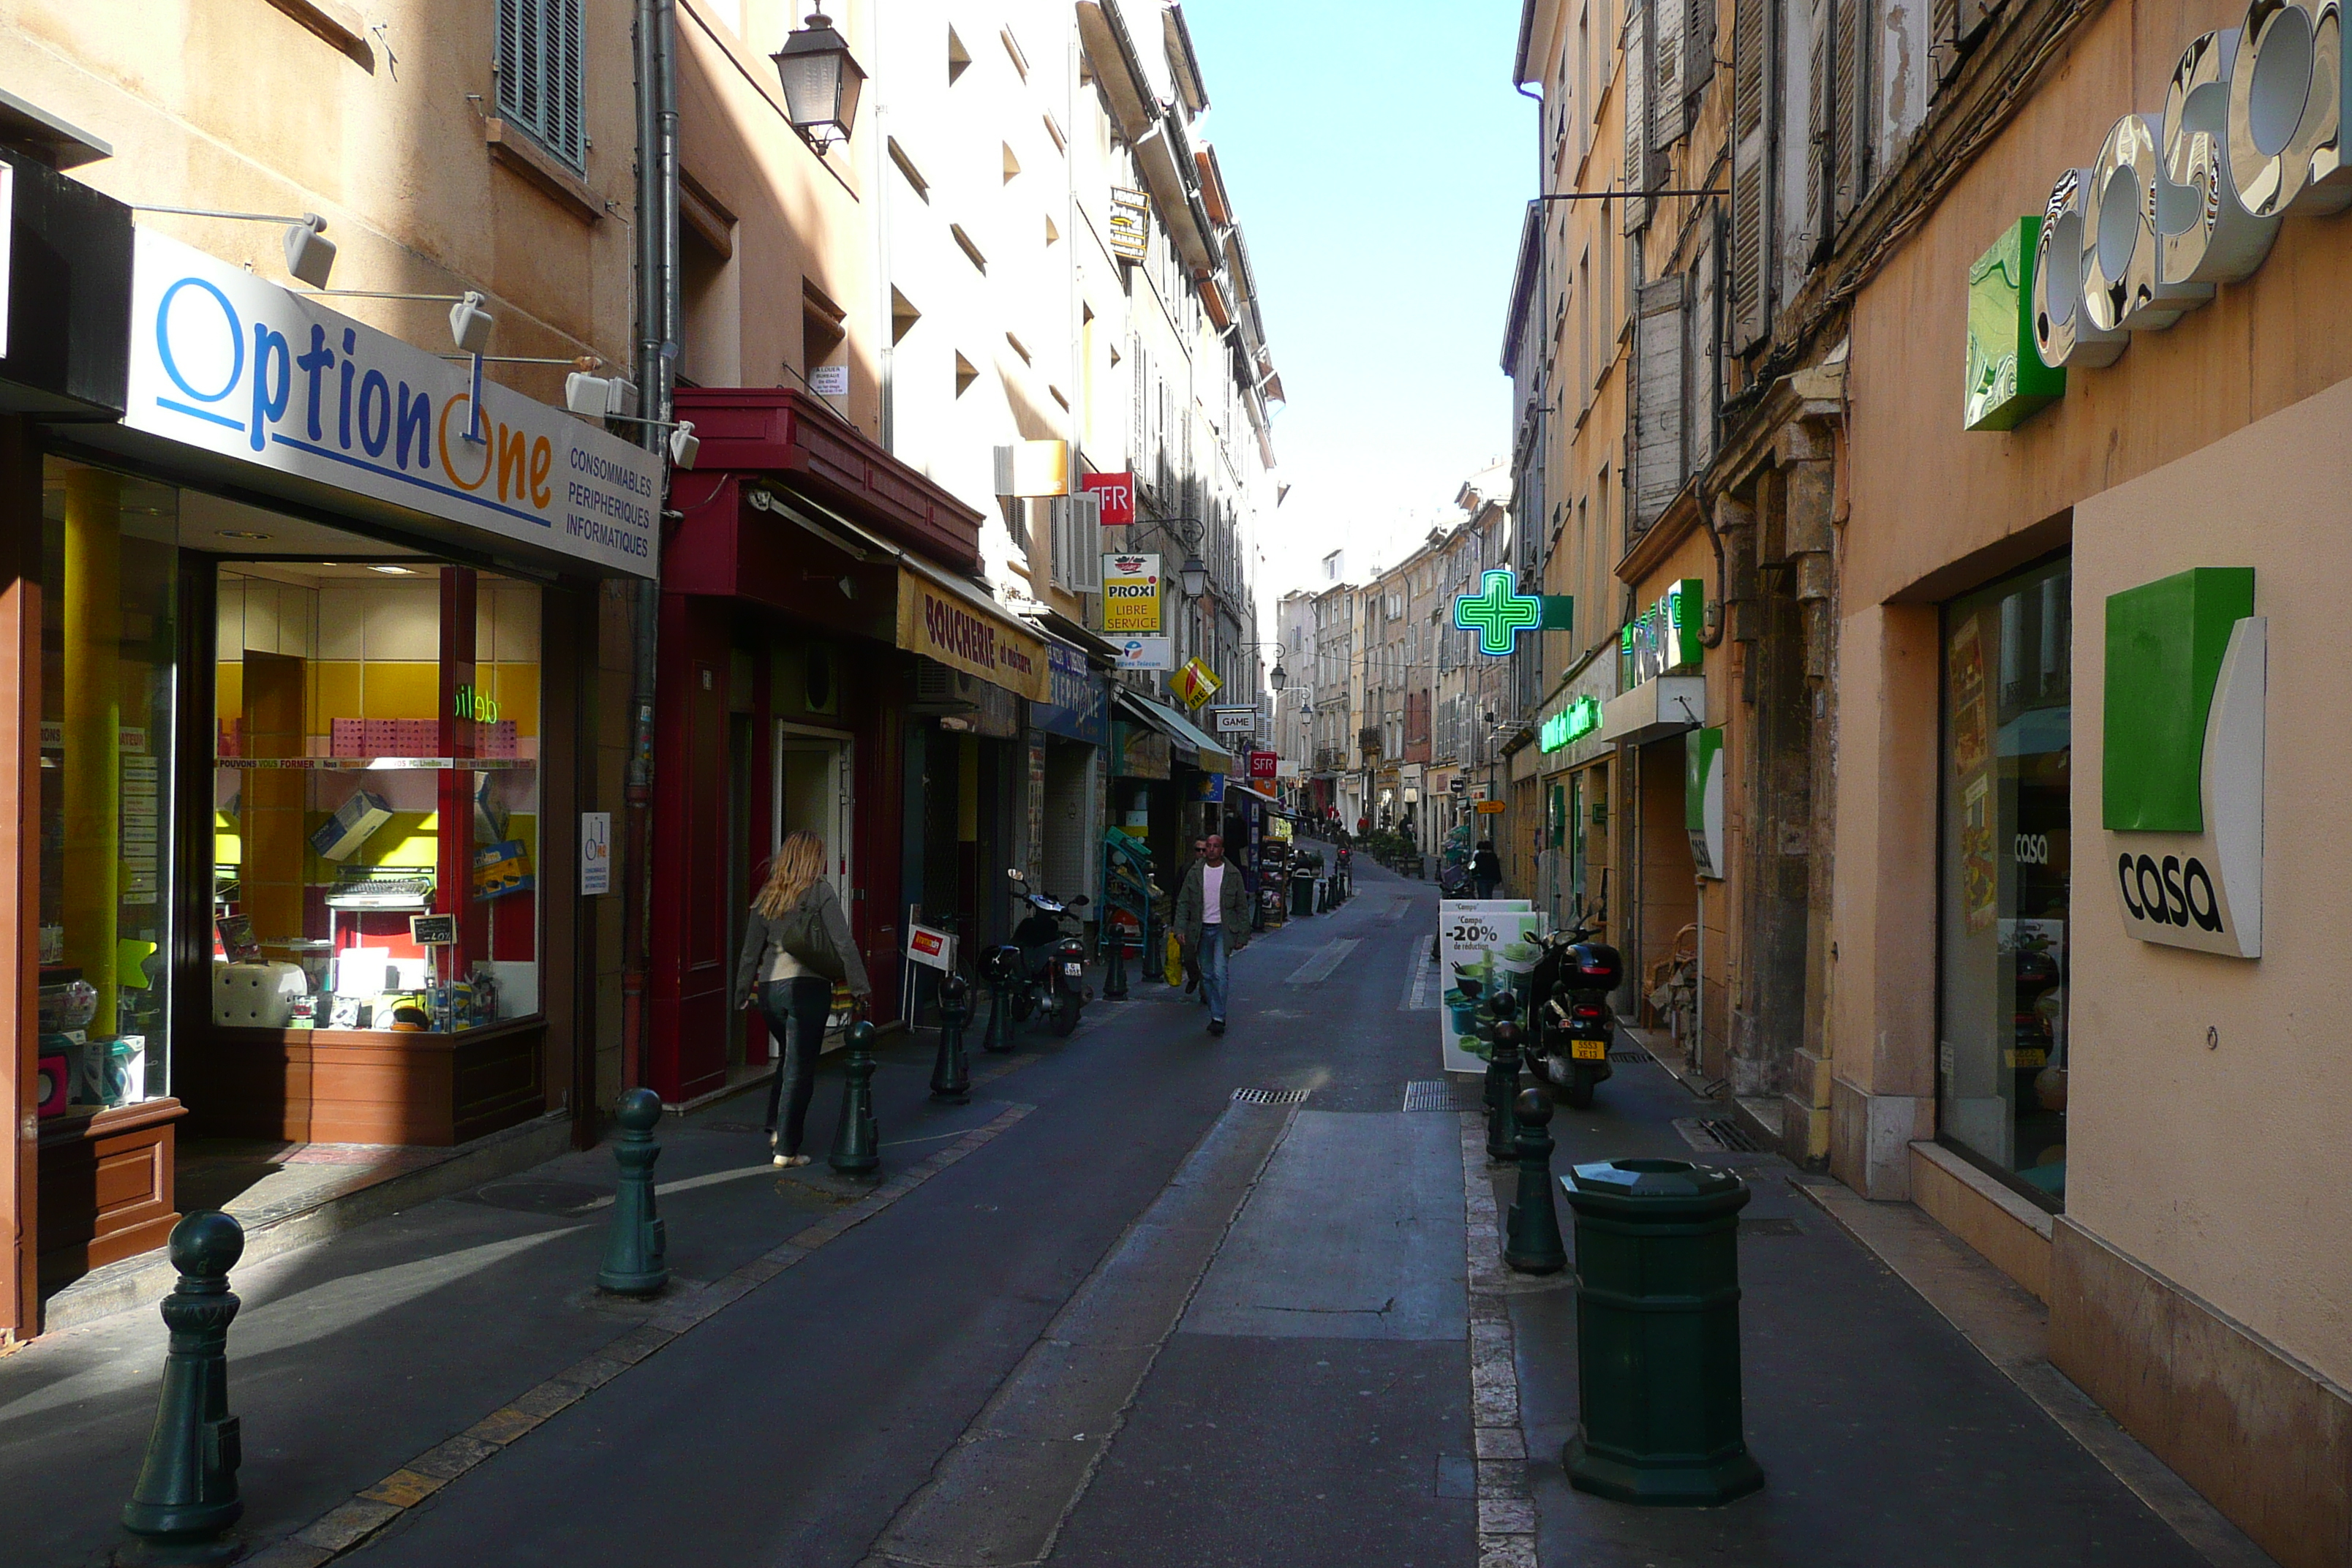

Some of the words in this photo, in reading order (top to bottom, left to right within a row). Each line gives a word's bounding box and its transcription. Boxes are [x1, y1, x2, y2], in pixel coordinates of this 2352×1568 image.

[570, 448, 652, 498] CONSOMMABLES
[568, 481, 649, 529] PERIPHERIQUES
[566, 513, 648, 558] INFORMATIQUES
[1109, 586, 1155, 598] PROXI
[1117, 605, 1147, 616] LIBRE
[1107, 618, 1157, 629] SERVICE
[925, 594, 995, 670] BOUCHERIE
[1222, 718, 1249, 726] GAME
[280, 760, 314, 768] FORMER
[1254, 758, 1273, 770] SFR
[2015, 834, 2048, 864] casa
[2119, 853, 2224, 933] casa
[1446, 926, 1498, 942] -20%
[1454, 942, 1461, 950] de
[1463, 942, 1489, 950] réduction
